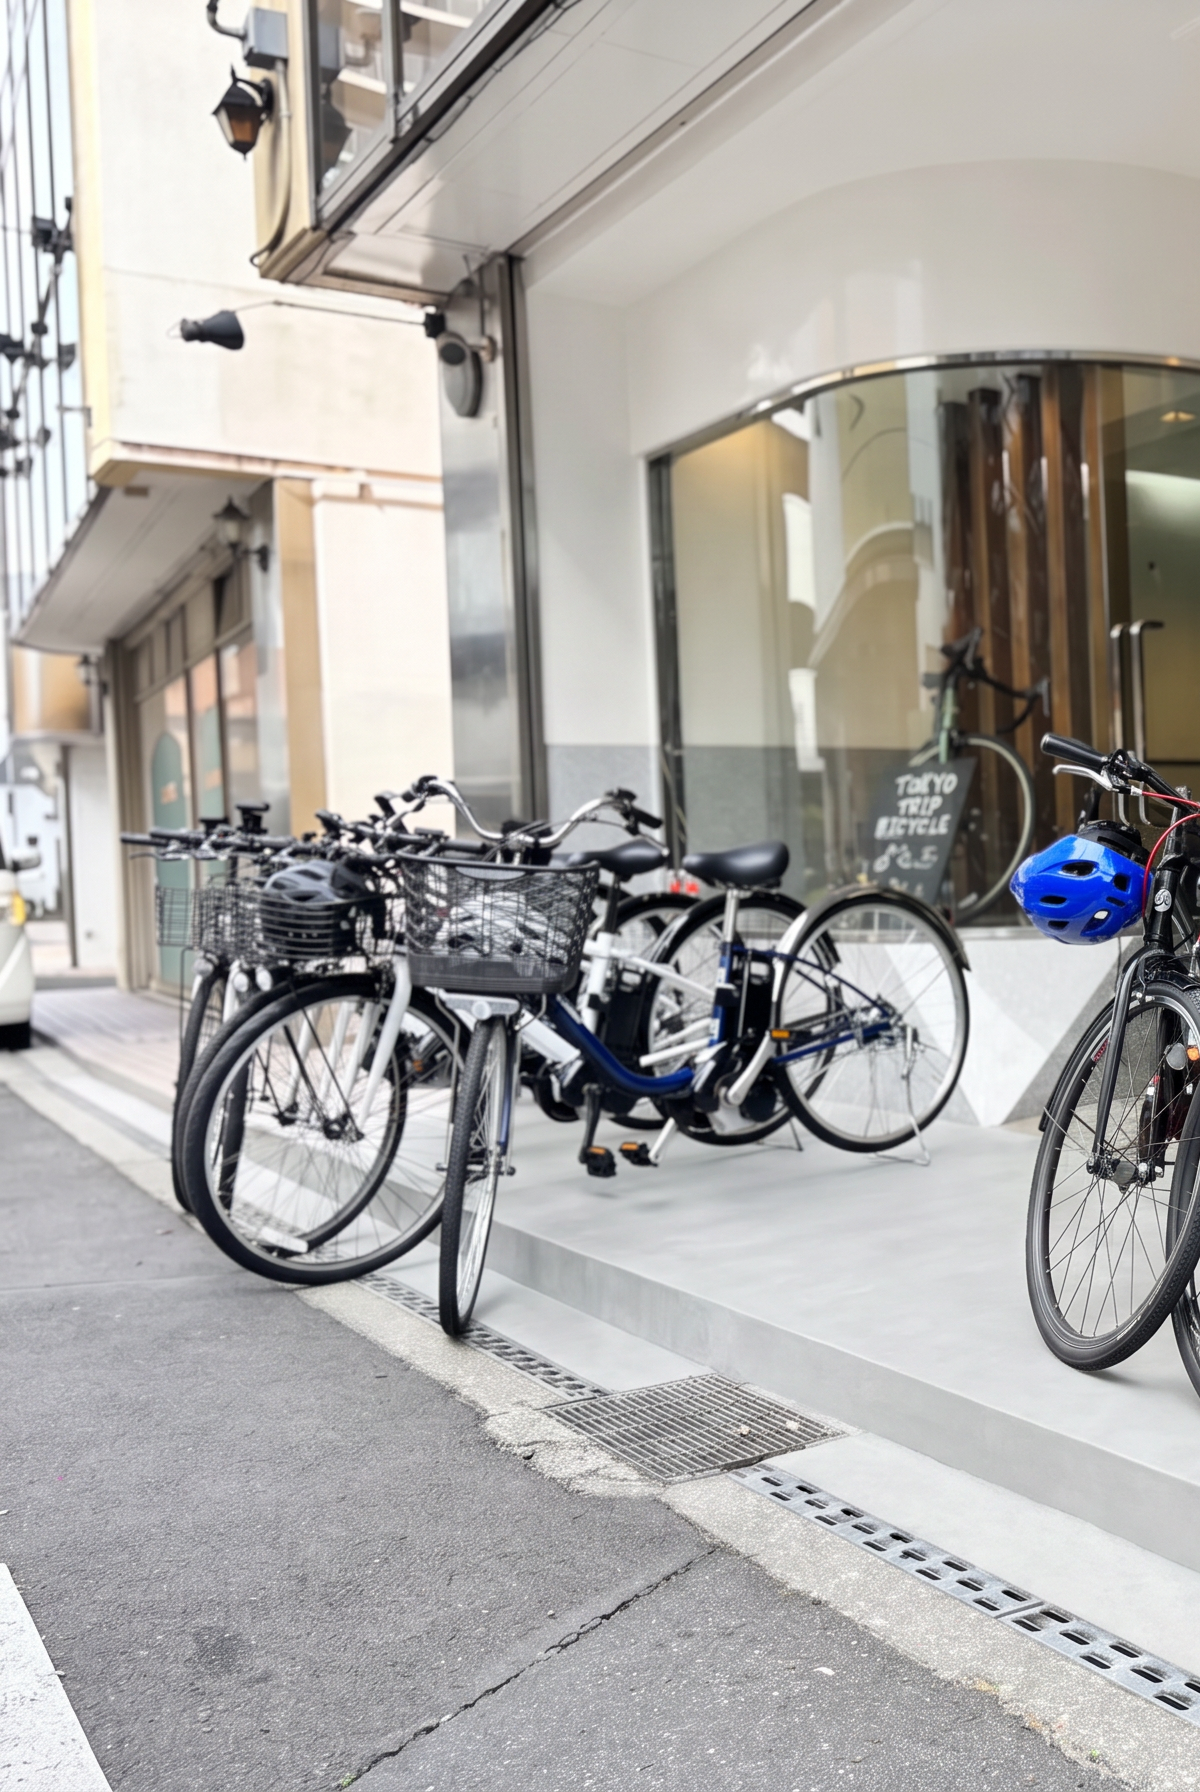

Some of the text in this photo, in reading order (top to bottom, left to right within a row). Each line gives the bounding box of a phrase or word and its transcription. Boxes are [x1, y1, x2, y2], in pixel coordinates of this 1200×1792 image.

[895, 772, 958, 796] TOKYO
[898, 795, 943, 817] TRIP
[874, 814, 951, 840] BICYCLE
